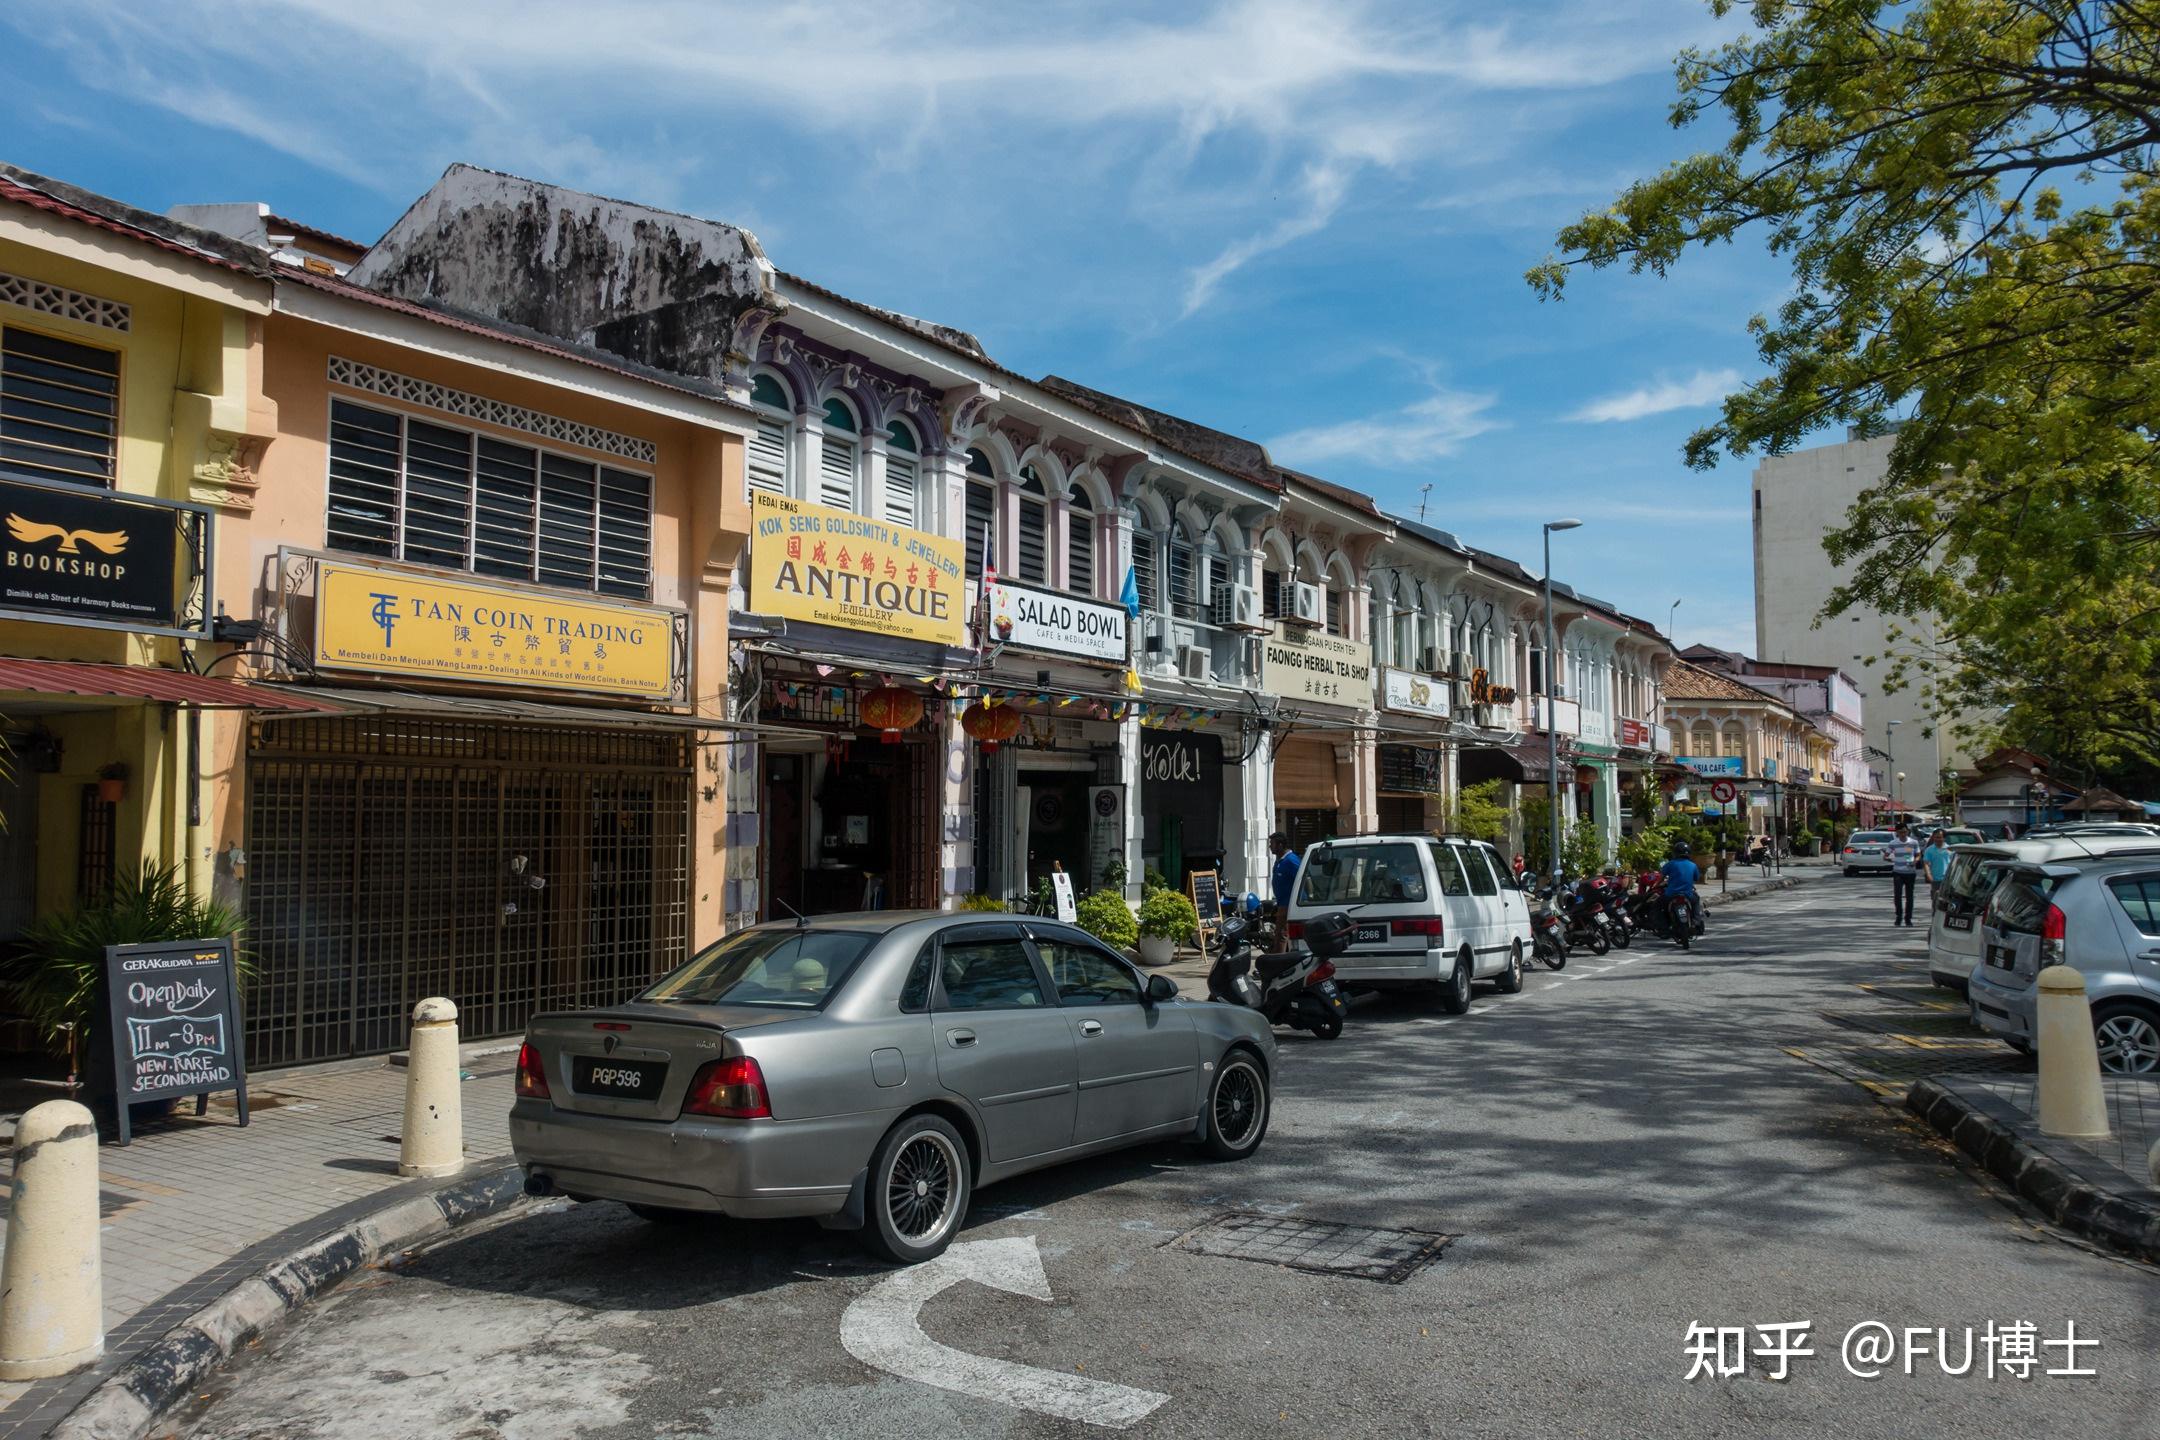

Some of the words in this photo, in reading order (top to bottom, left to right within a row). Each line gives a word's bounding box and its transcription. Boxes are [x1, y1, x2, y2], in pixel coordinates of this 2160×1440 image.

[758, 495, 778, 509] KEDAI
[780, 499, 798, 513] EMAS
[758, 517, 783, 537] KOK
[789, 516, 821, 533] SENG
[826, 517, 888, 543] GOLDSMITH
[892, 532, 900, 547] &
[905, 538, 960, 580] JEWELLERY
[7, 551, 126, 580] BOOKSHOP
[7, 588, 33, 599] Dimiliki
[34, 591, 49, 600] oleh
[51, 594, 71, 603] Street
[72, 595, 80, 603] of
[81, 597, 110, 608] Harmony
[111, 600, 130, 609] Books
[775, 560, 949, 621] ANTIQUE
[411, 598, 463, 622] TAN
[474, 607, 534, 631] COIN
[544, 616, 643, 645] TRADING
[838, 603, 894, 622] JEWELLERY
[1018, 597, 1071, 630] SALAD
[1077, 610, 1123, 640] BOWL
[1036, 629, 1054, 639] CAFE
[1064, 634, 1084, 644] MEDIA
[1086, 637, 1105, 648] SPACE
[338, 649, 378, 661] Membeli
[381, 650, 398, 662] Dan
[400, 655, 434, 667] Menjual
[436, 659, 460, 670] Wang
[461, 661, 483, 671] Lama
[489, 664, 519, 676] Dealing
[521, 667, 528, 675] In
[530, 668, 541, 676] All
[542, 669, 563, 679] Kinds
[565, 671, 574, 680] of
[575, 672, 596, 682] World
[621, 677, 638, 687] Bank
[639, 679, 658, 688] Notes
[1267, 647, 1302, 668] FAONGG
[1304, 657, 1334, 674] HERBAL
[1336, 661, 1350, 678] TEA
[1352, 664, 1369, 682] SHOP
[1709, 764, 1726, 773] CAFE
[128, 982, 175, 1007] Open
[167, 978, 216, 1013] Daily
[132, 1067, 230, 1092] SECONDHAND
[592, 1067, 641, 1088] PGP596
